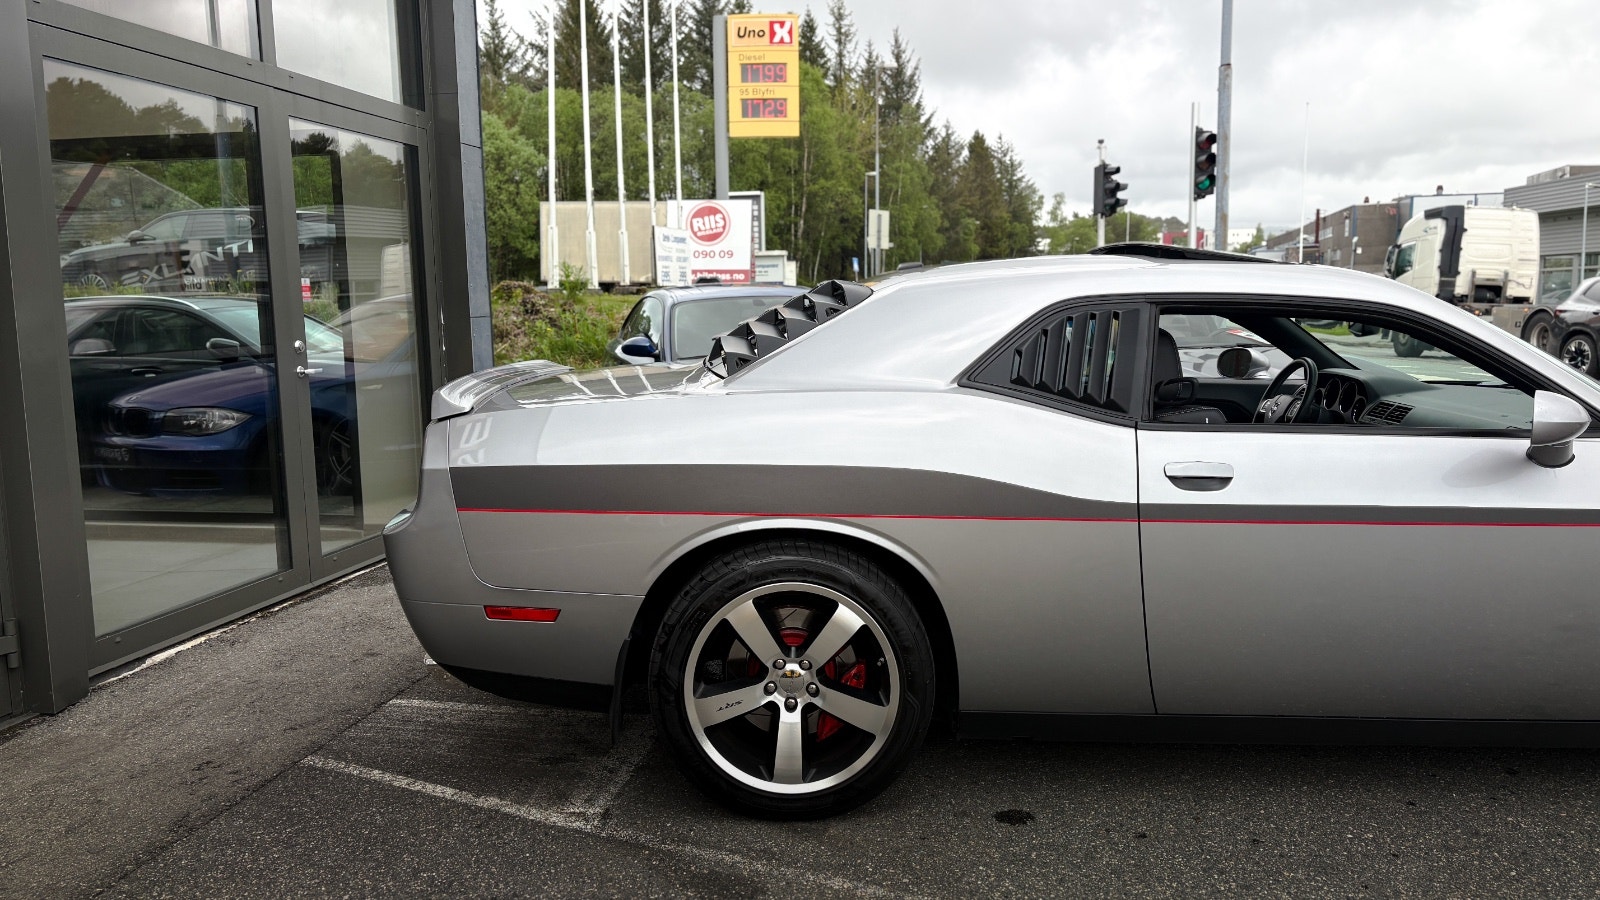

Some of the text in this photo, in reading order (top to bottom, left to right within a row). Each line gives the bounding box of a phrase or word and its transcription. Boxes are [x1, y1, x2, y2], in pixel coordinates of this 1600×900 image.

[737, 27, 766, 38] Uno
[738, 53, 765, 61] Diesel
[739, 88, 775, 97] 95 Blyfri
[692, 213, 725, 233] RIIS
[693, 250, 715, 259] 090
[719, 250, 734, 259] 09
